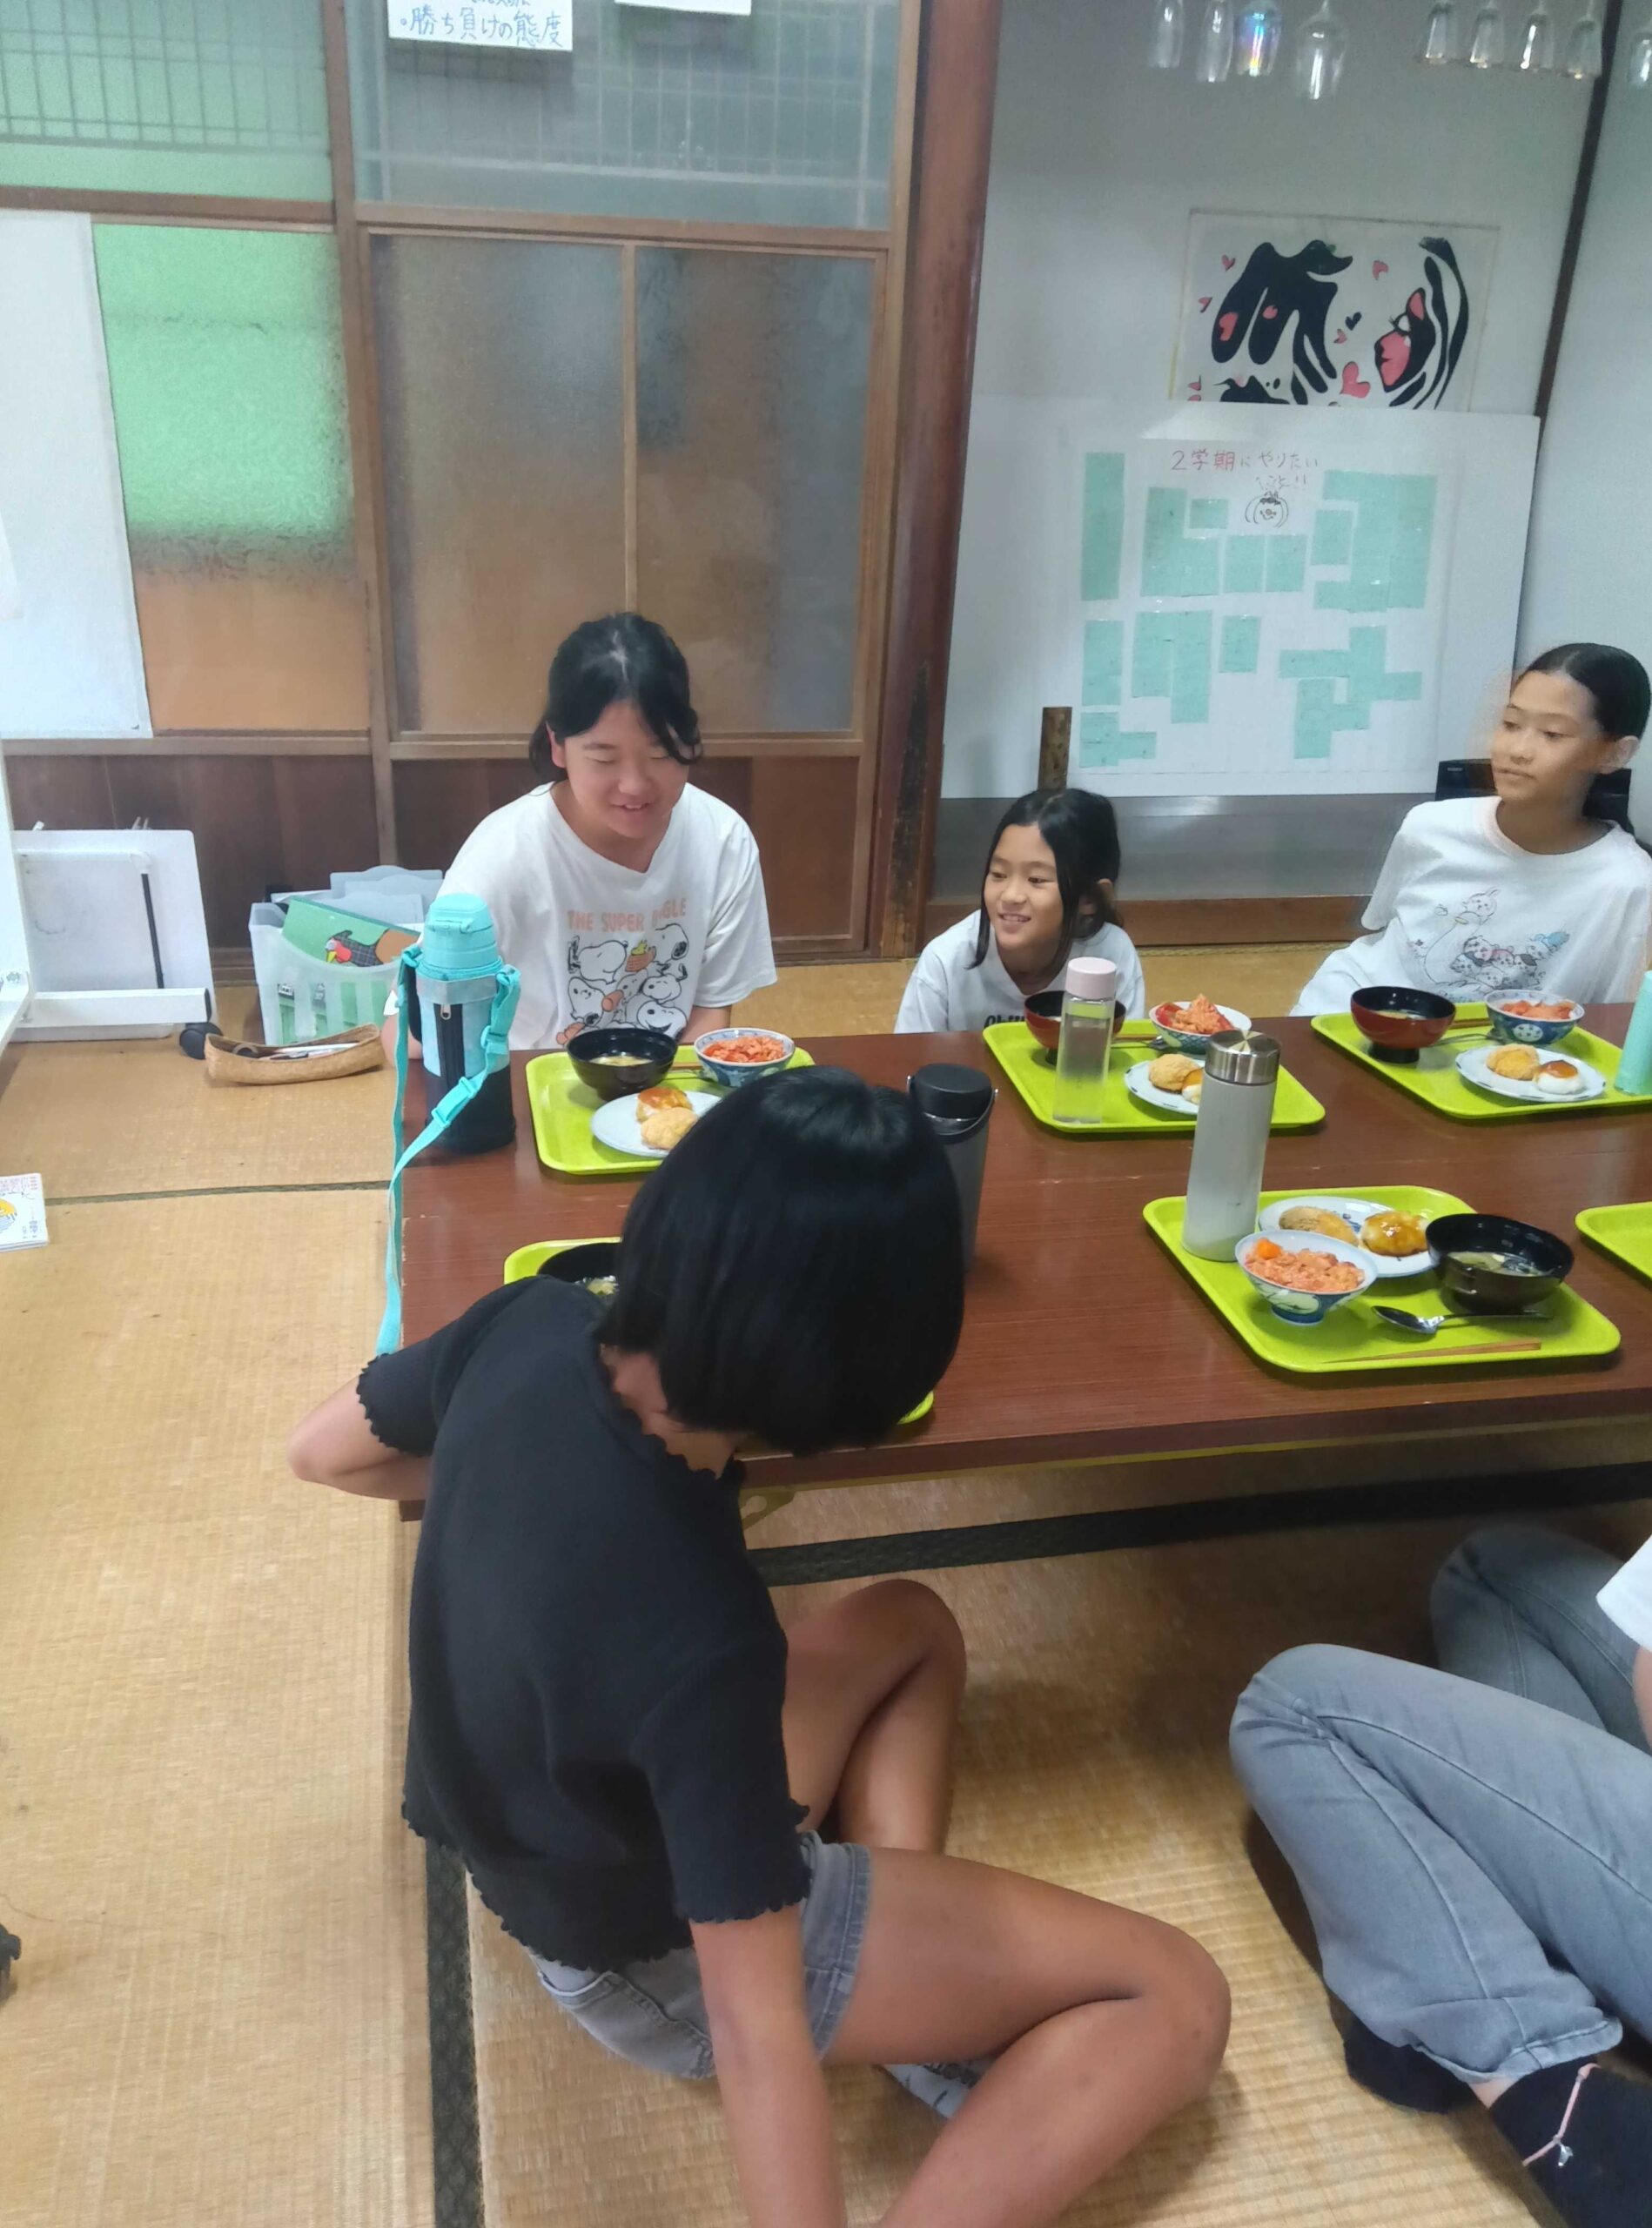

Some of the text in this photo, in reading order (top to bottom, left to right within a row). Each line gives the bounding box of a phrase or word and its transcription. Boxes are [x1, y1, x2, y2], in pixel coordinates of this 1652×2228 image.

[567, 897, 686, 932] THE SUPER GLE
